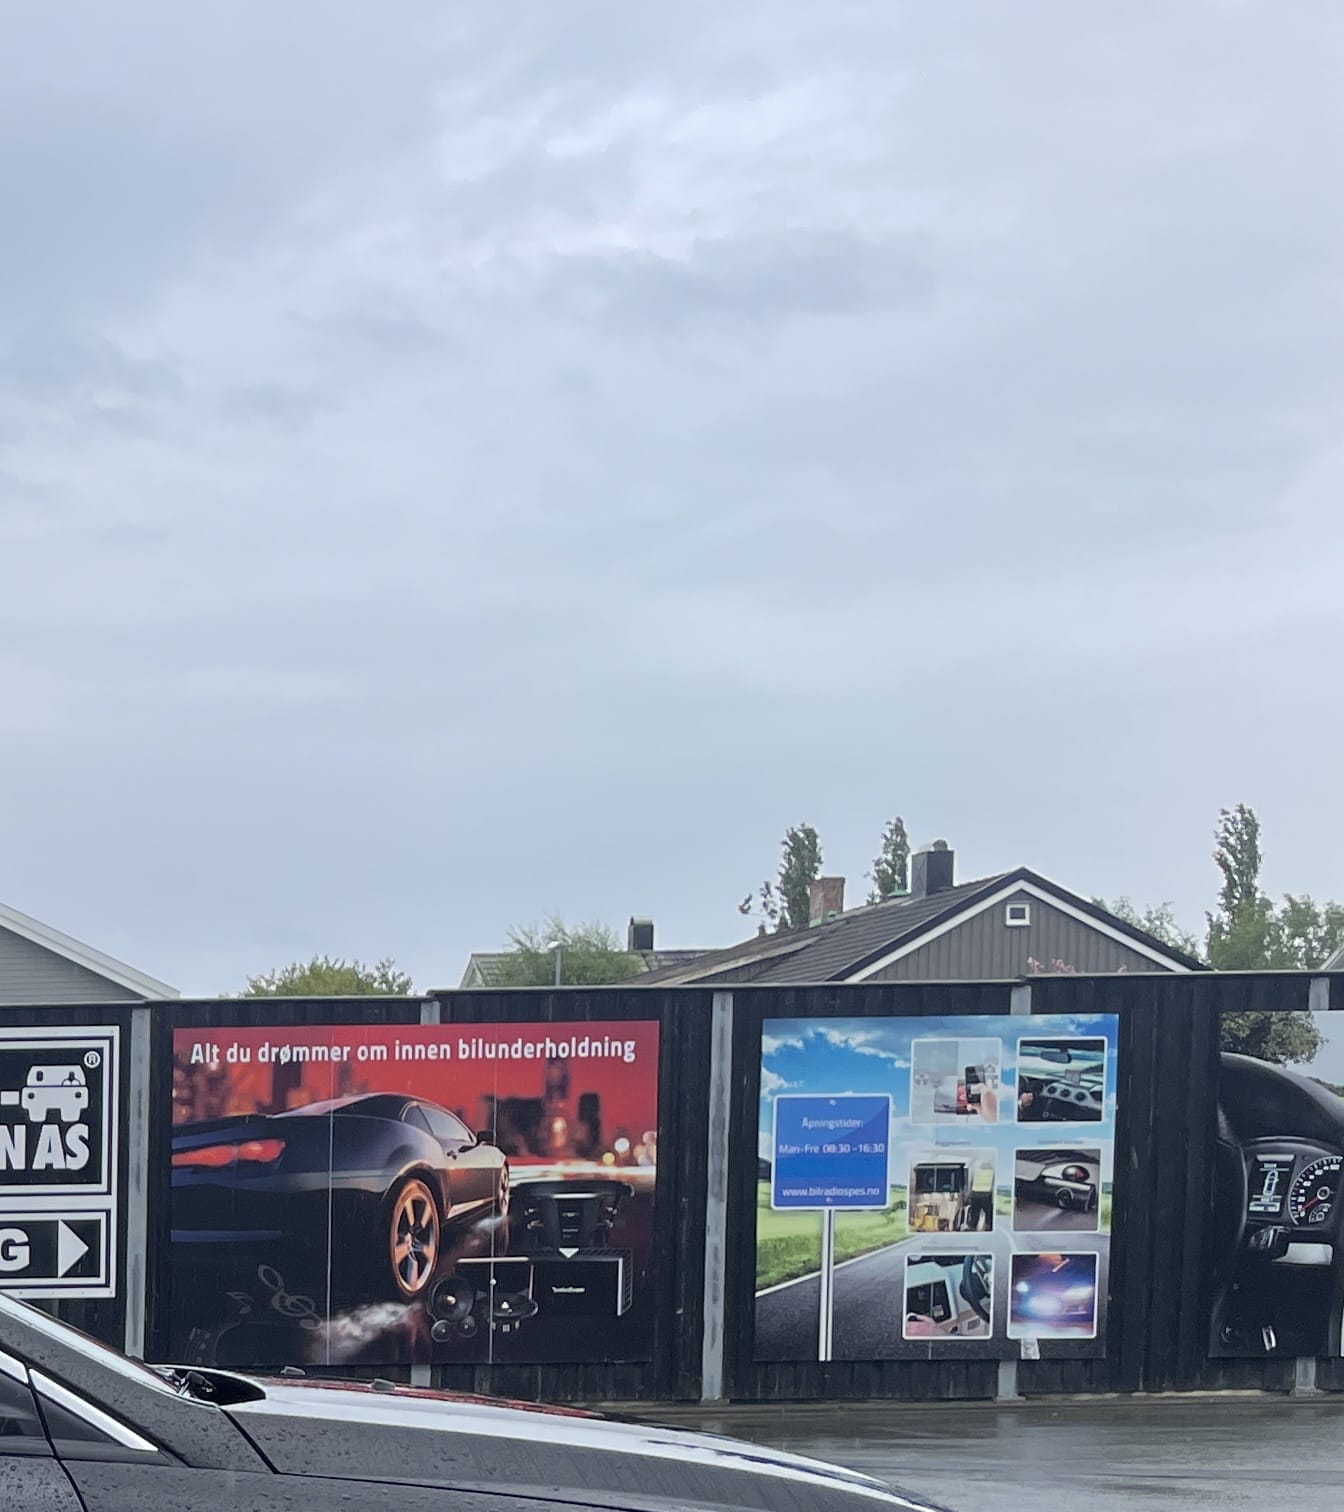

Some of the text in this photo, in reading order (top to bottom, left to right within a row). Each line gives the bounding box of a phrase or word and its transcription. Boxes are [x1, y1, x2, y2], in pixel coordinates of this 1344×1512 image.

[190, 1036, 636, 1065] Alt du drømmer om innen bilunderholdning
[31, 1123, 90, 1171] AS
